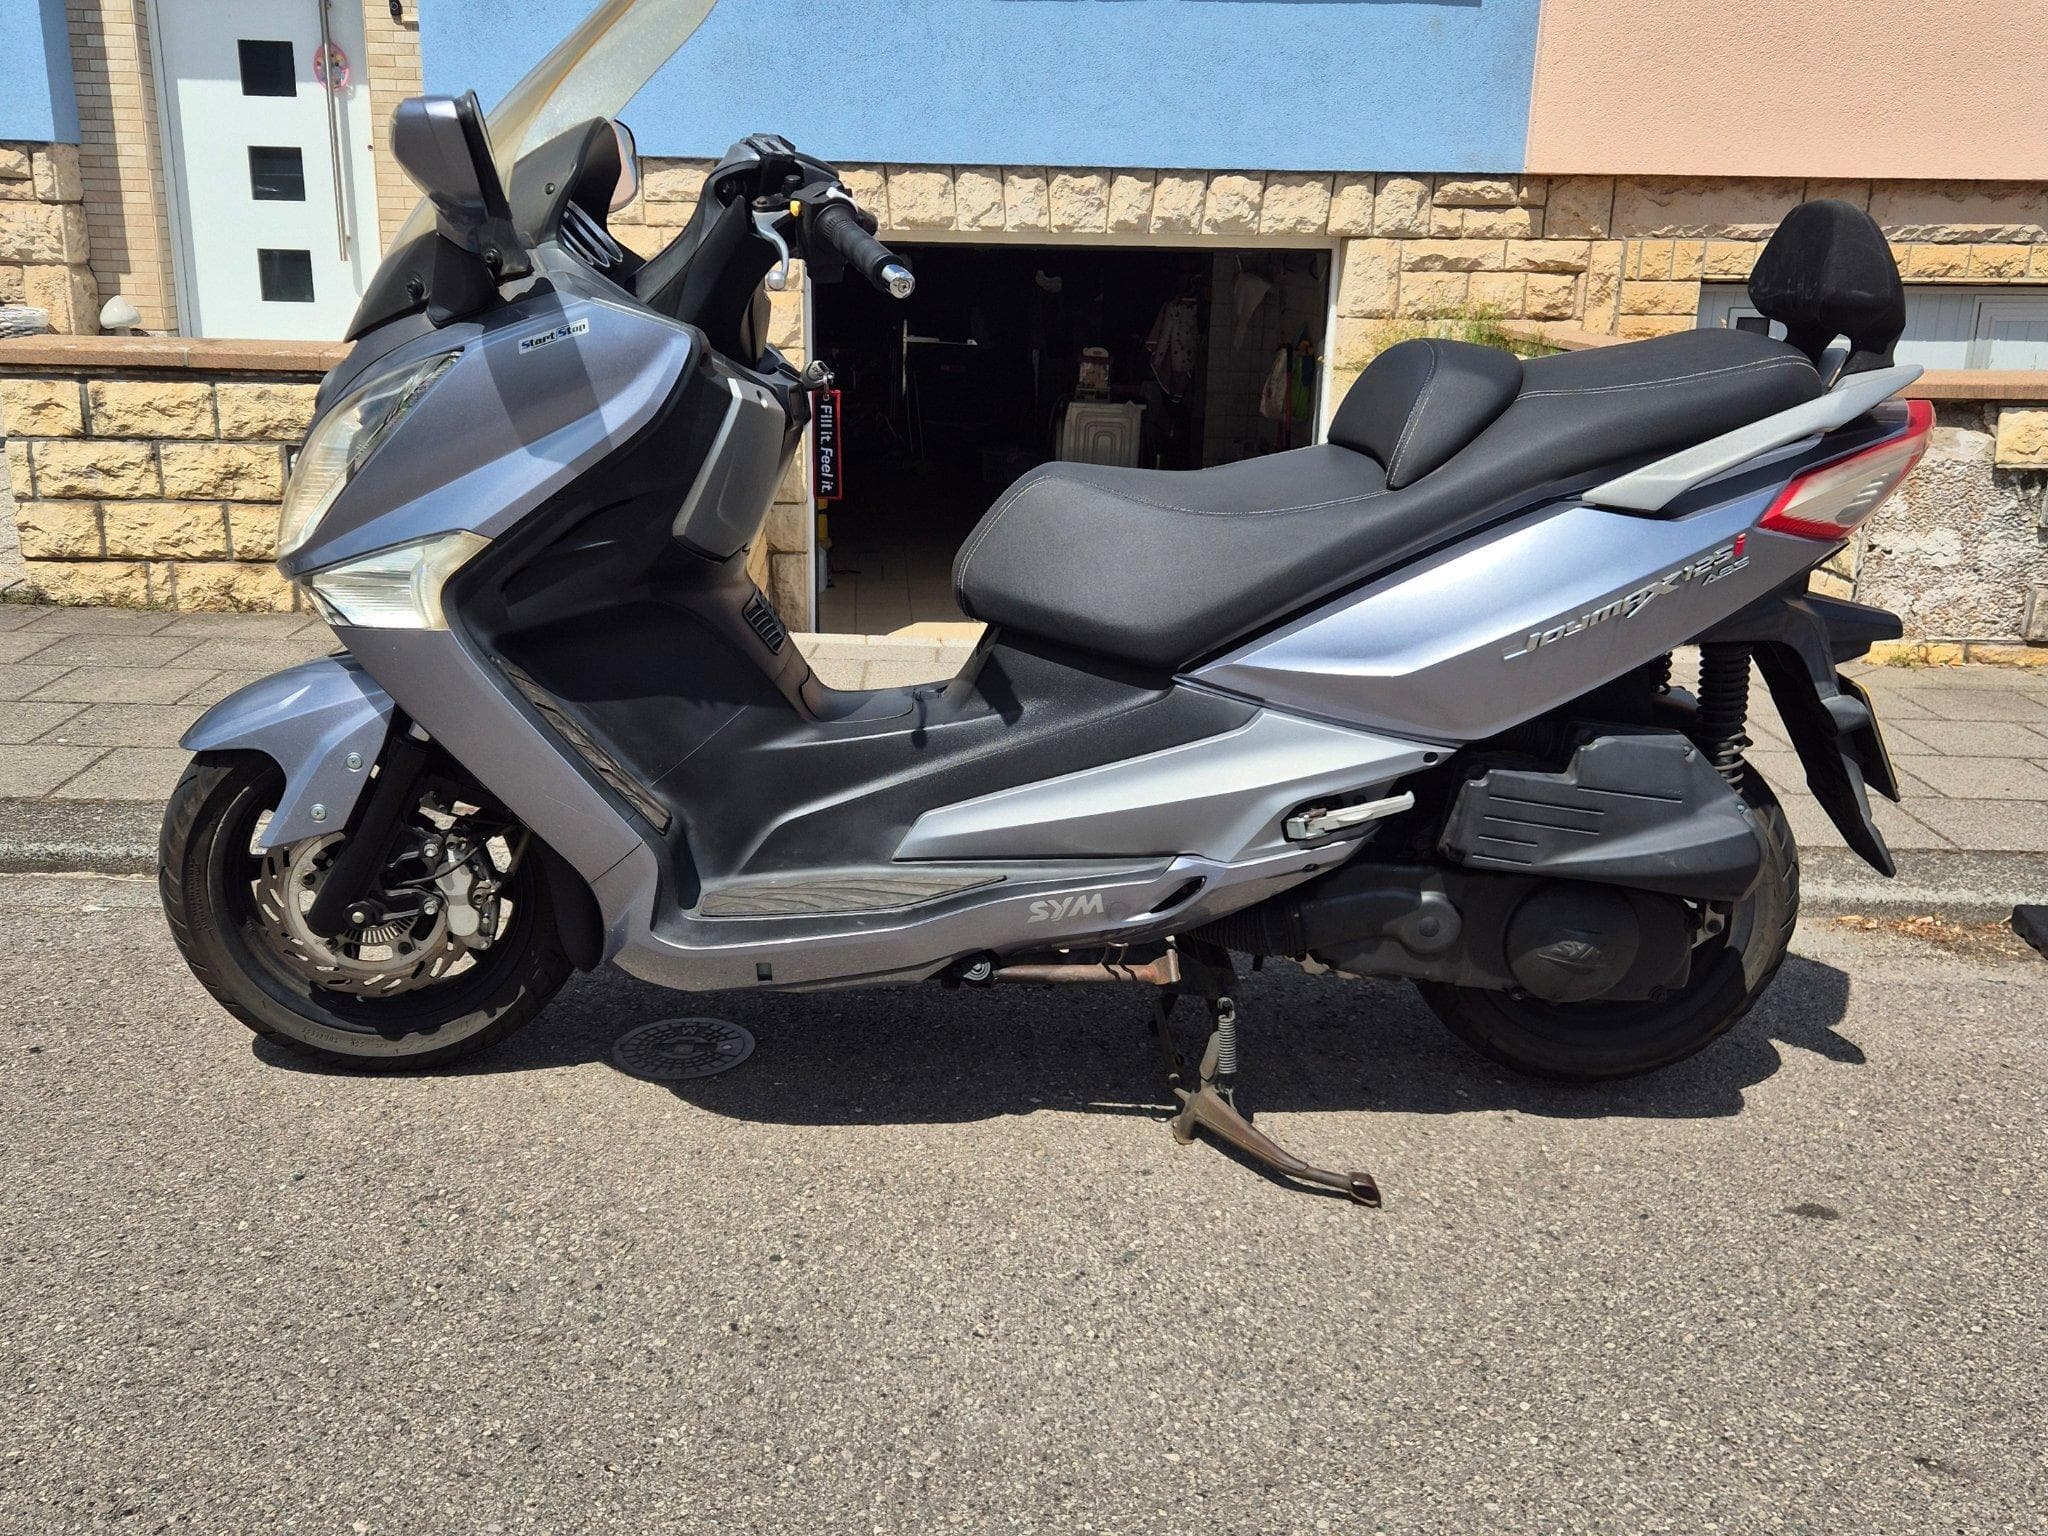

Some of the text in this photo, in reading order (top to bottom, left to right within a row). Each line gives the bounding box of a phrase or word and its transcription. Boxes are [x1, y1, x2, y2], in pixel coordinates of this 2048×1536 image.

[521, 324, 586, 350] Start Stop
[820, 405, 833, 493] Fill it. Feel it.
[1702, 556, 1750, 586] ABS
[1027, 893, 1104, 923] SYM
